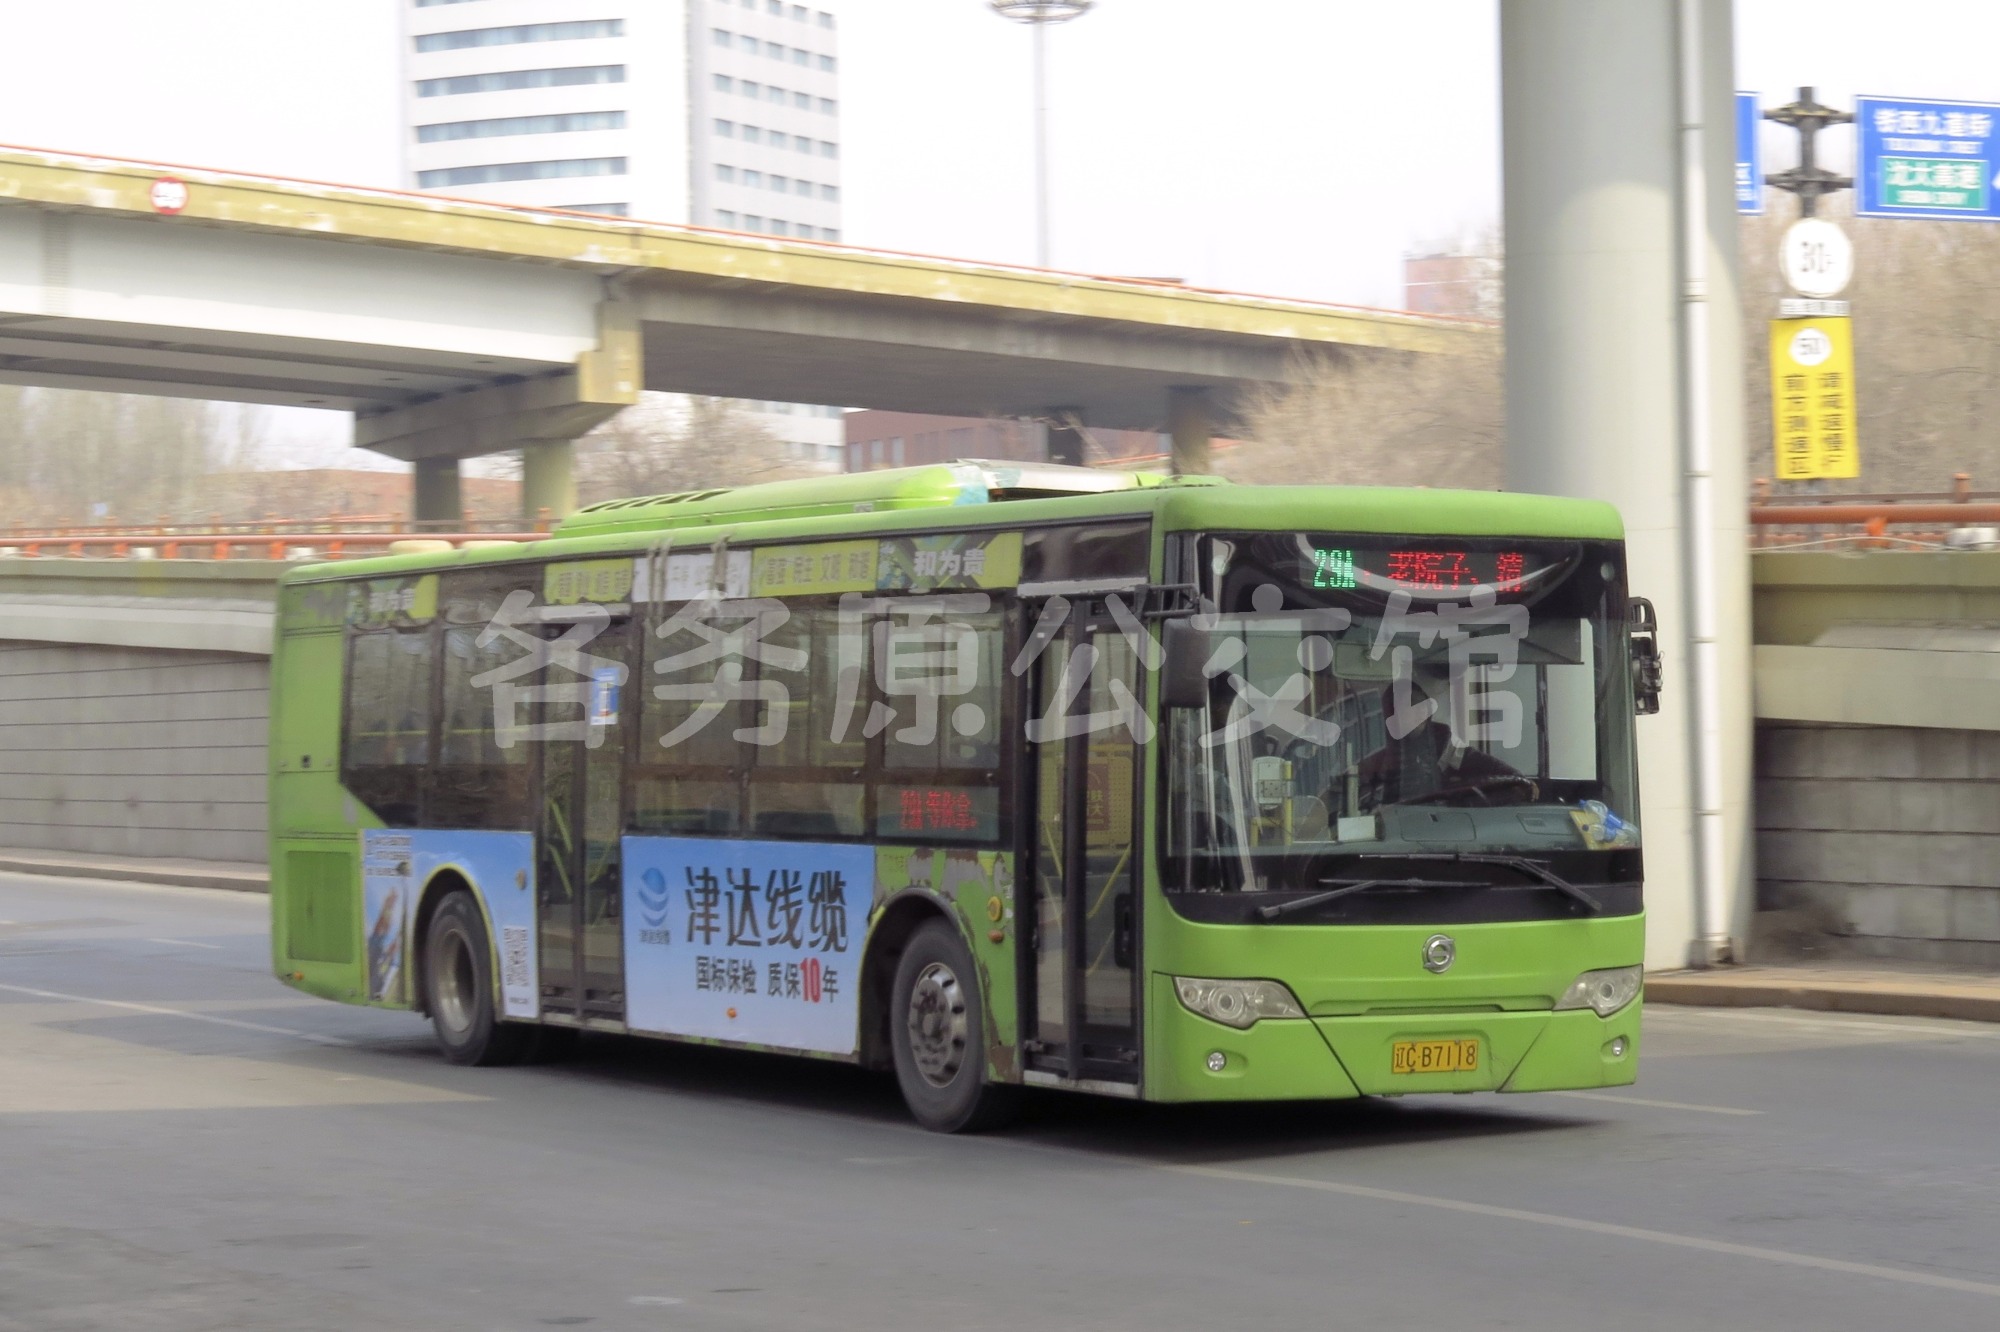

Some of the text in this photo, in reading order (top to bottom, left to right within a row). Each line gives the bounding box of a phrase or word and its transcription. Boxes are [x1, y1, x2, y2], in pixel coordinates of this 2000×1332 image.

[914, 548, 986, 577] 和为贵
[684, 865, 849, 953] 津达线缆
[696, 955, 839, 1003] 国标保检 质保10年
